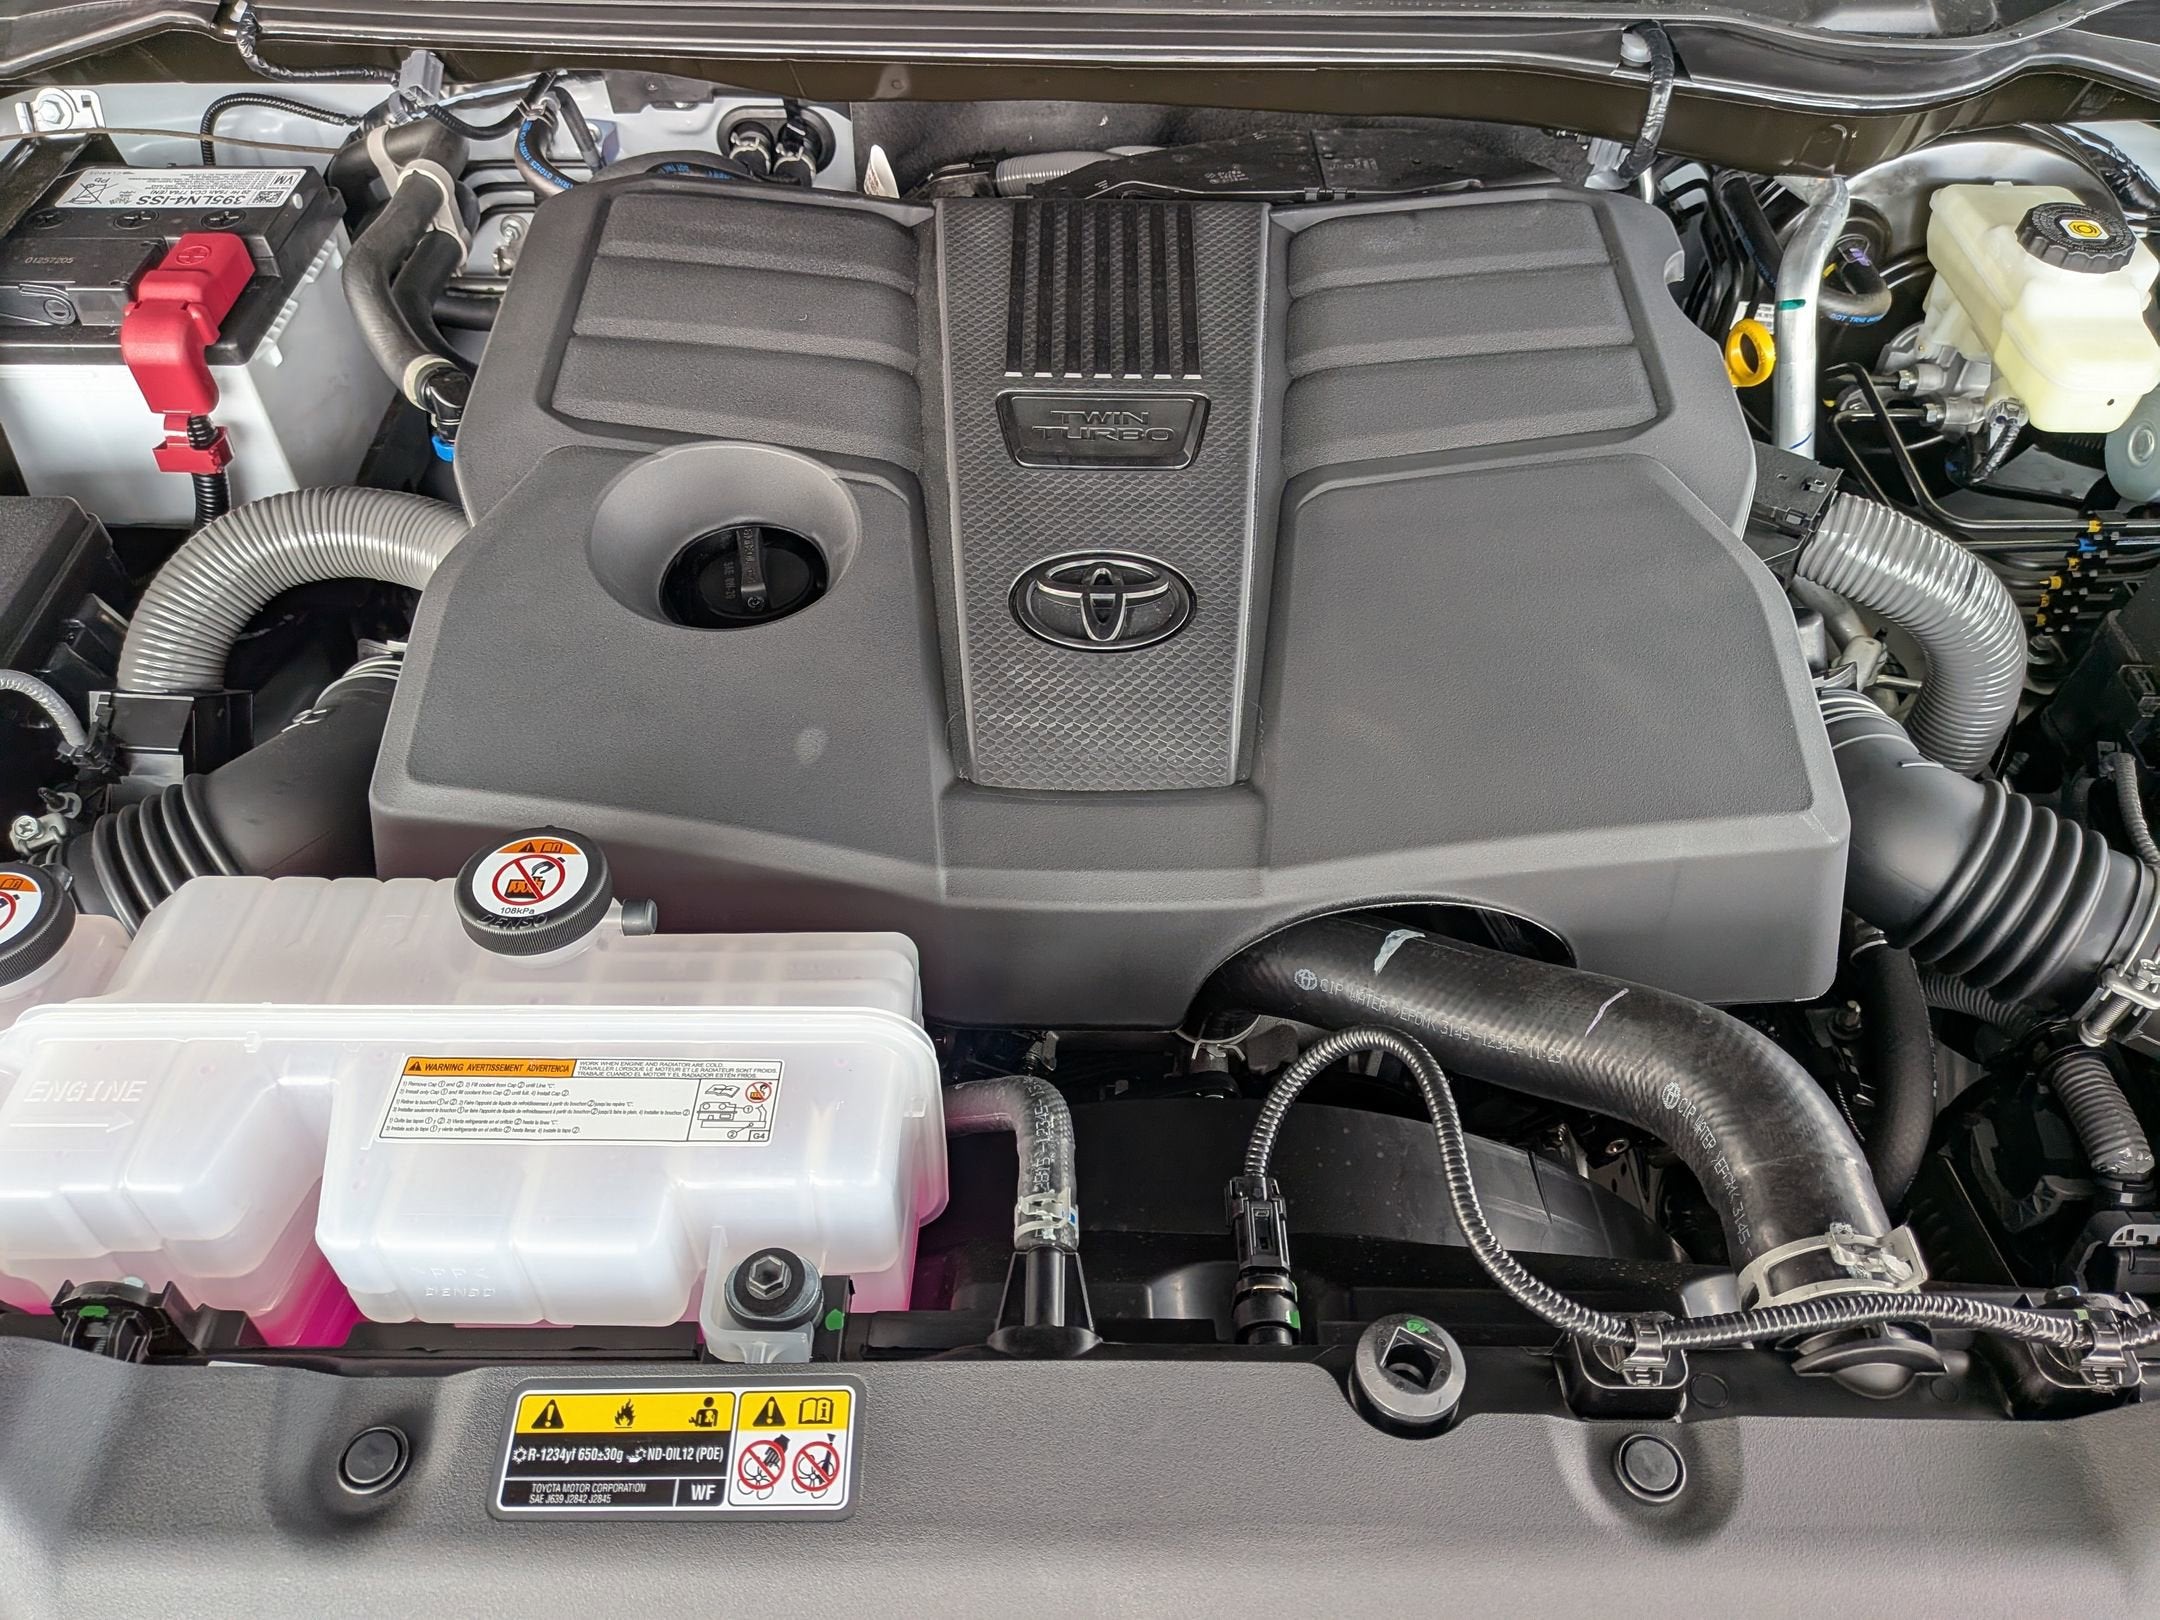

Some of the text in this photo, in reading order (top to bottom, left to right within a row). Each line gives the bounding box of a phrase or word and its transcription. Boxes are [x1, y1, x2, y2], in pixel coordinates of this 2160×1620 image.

[274, 175, 293, 185] VM
[136, 195, 245, 206] 395LN4-ISS
[1050, 410, 1149, 425] TWIN
[1032, 425, 1175, 441] TURBO
[500, 907, 536, 915] 108kPa
[476, 914, 549, 930] DENSO
[1350, 988, 1389, 1014] WATER
[424, 1063, 569, 1073] WARNING AVERTISSEMENT ADVERTENCIA
[23, 1080, 148, 1103] ENGINE
[527, 1448, 576, 1464] R-1234yf
[578, 1447, 624, 1463] 650±30g
[696, 1447, 724, 1463] (POE)
[562, 1483, 591, 1493] MOTOR
[592, 1482, 647, 1493] CORPORATION
[690, 1483, 717, 1501] WF
[529, 1494, 611, 1504] SAE J639 J2842 J2845
